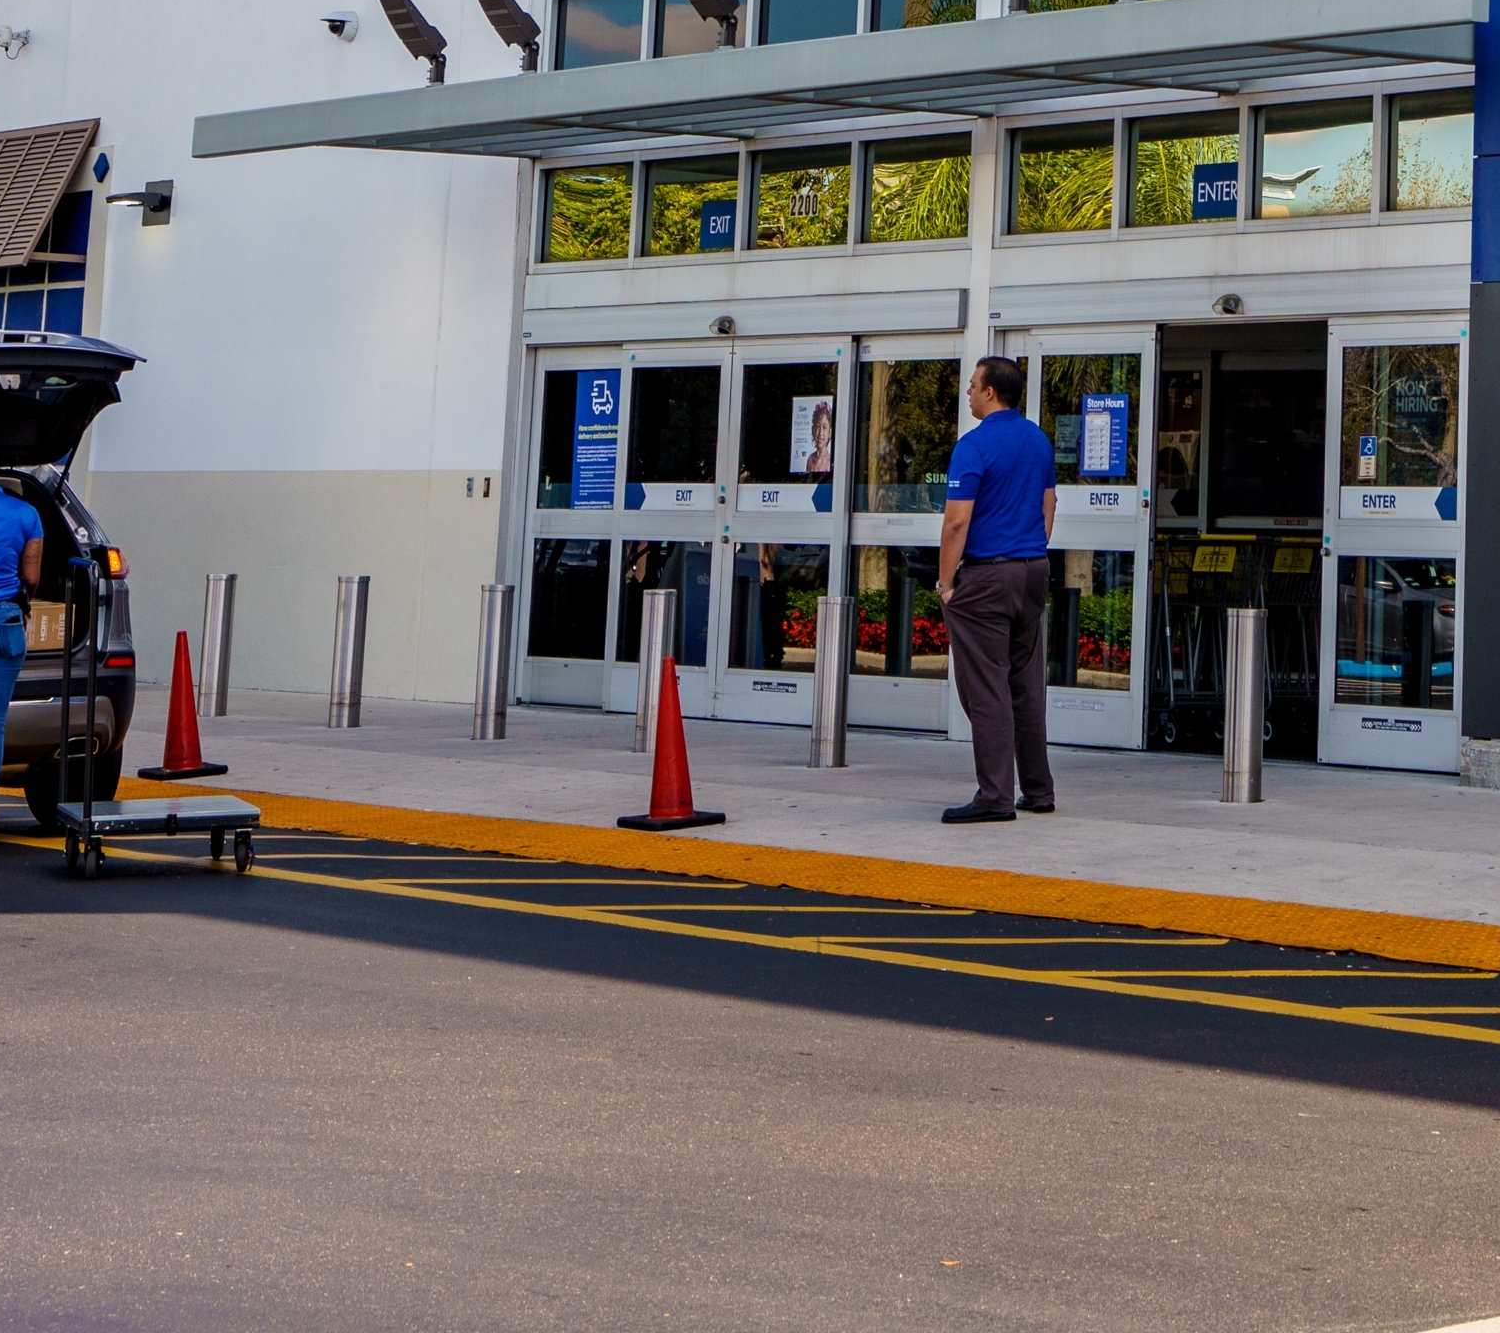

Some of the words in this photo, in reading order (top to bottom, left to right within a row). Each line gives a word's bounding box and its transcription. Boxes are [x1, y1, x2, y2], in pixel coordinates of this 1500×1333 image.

[1198, 181, 1238, 203] ENTER
[790, 194, 818, 216] 2200
[710, 216, 731, 234] EXIT
[1395, 380, 1426, 396] NOW
[1087, 398, 1105, 408] Store
[1105, 398, 1125, 408] Hours
[1395, 396, 1438, 413] HIRING
[925, 472, 948, 484] SUN
[675, 489, 693, 502] EXIT
[762, 491, 780, 503] EXIT
[1089, 492, 1119, 506] ENTER
[1362, 494, 1396, 509] ENTER
